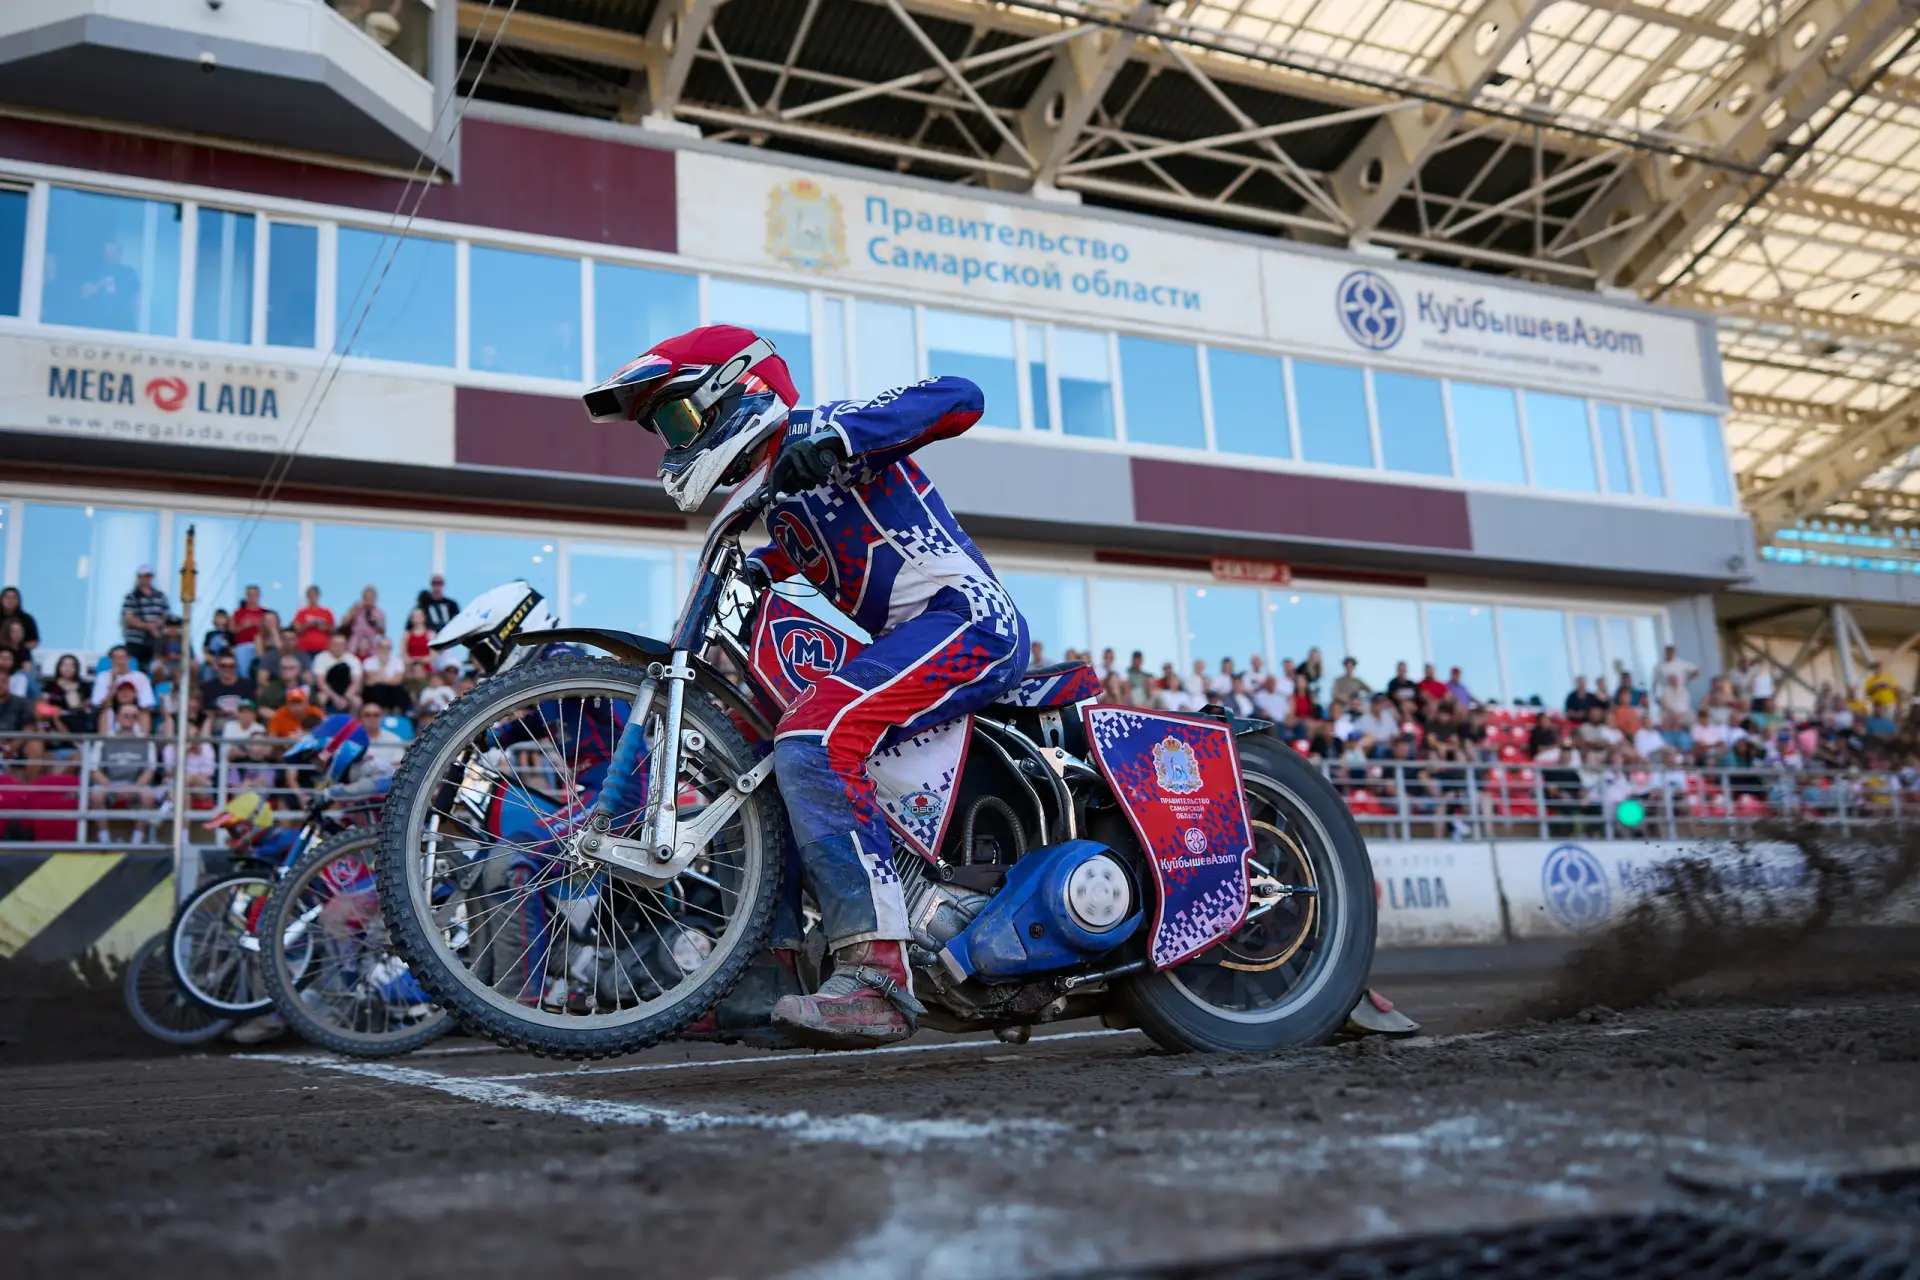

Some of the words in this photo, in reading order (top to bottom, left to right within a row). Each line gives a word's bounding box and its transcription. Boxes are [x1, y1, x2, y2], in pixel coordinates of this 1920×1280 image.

[864, 195, 1130, 264] Правительство
[867, 236, 1063, 292] Самарской
[1071, 268, 1202, 312] области
[1416, 290, 1645, 356] КуйбышевАзот
[48, 365, 135, 405] MEGA
[197, 381, 279, 418] LADA
[788, 422, 808, 436] LADA
[1160, 797, 1210, 805] ПРАВИТЕЛЬСТВО
[1169, 804, 1205, 812] САМАРСКОЙ
[1176, 812, 1203, 820] ОБЛАСТИ
[1160, 853, 1238, 873] КуйбышевАзот
[1386, 877, 1451, 910] LADA
